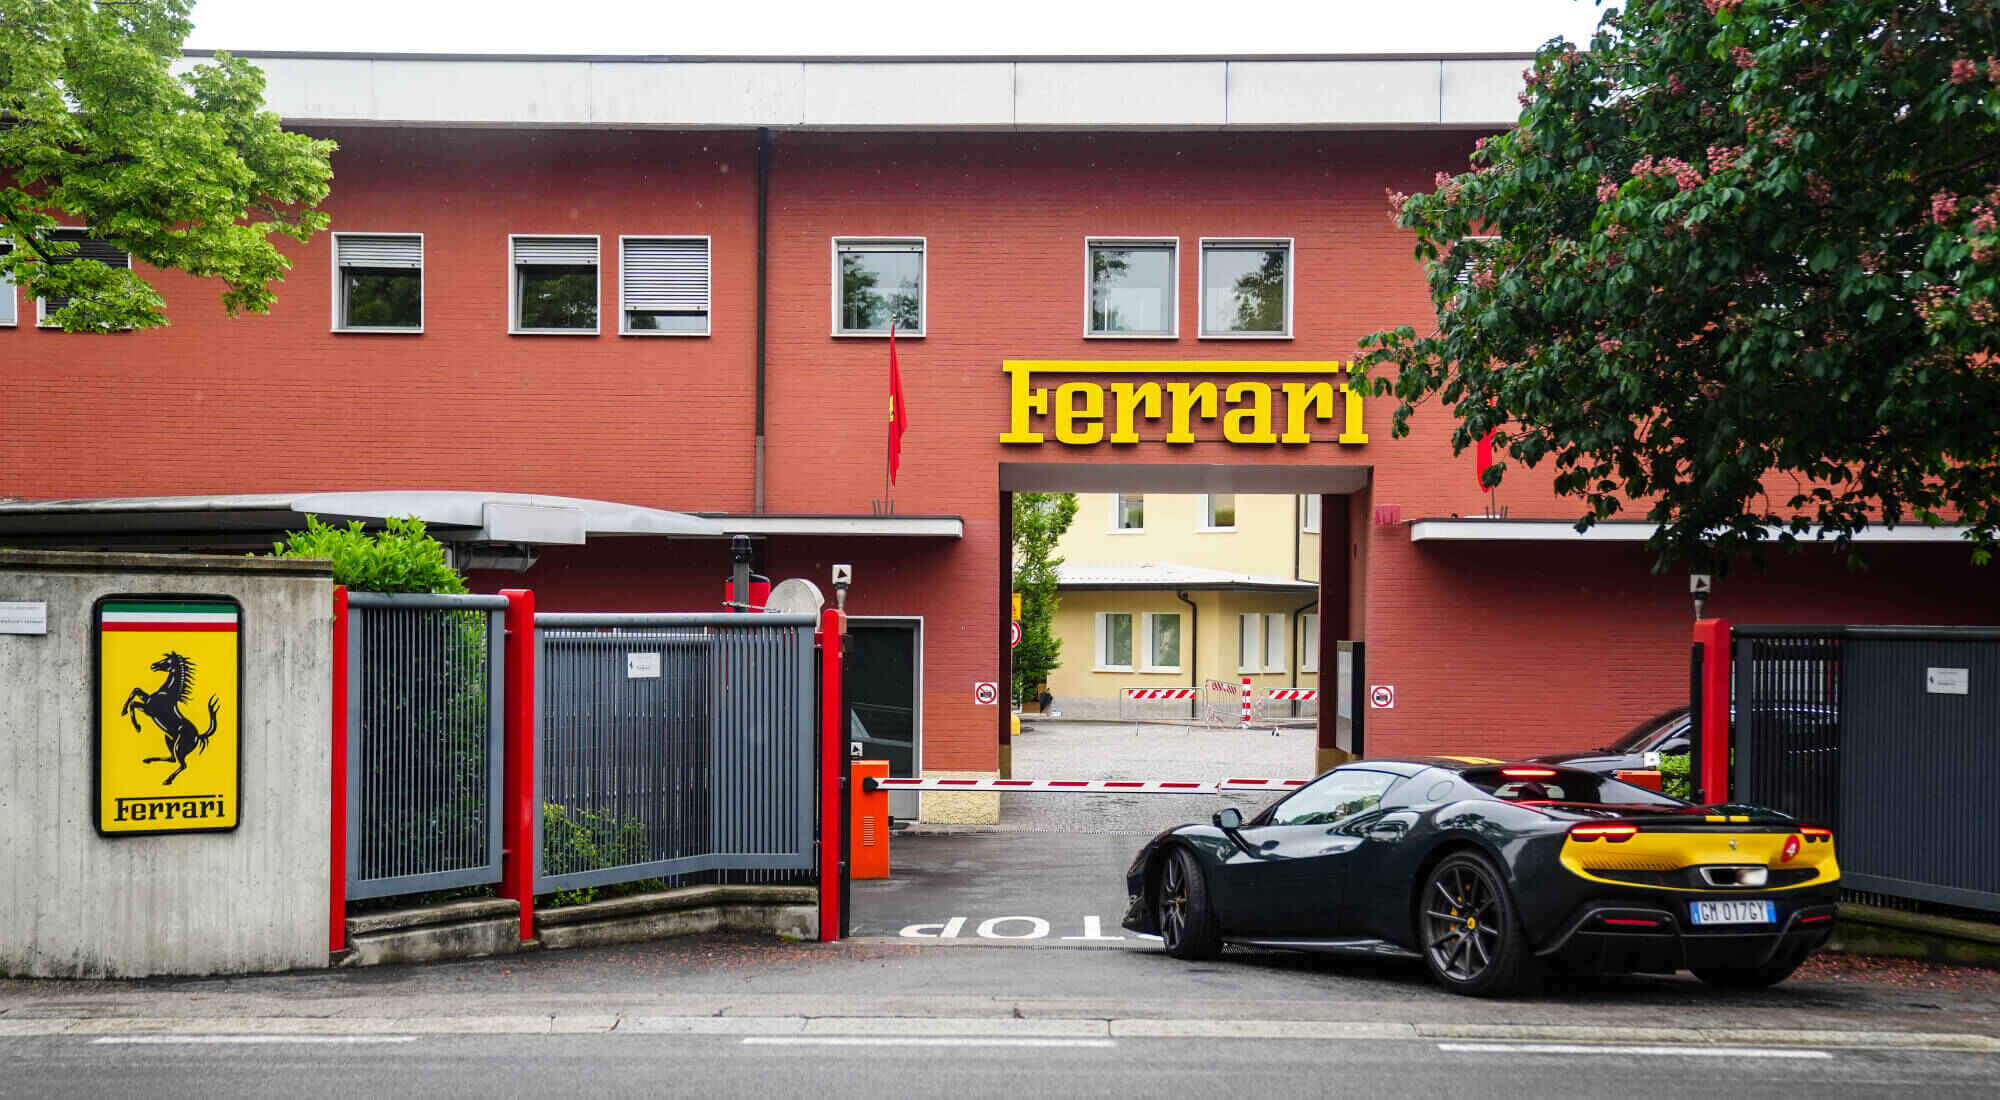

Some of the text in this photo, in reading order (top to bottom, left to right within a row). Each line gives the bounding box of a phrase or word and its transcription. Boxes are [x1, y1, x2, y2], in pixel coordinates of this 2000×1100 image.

[1000, 360, 1368, 444] Ferrari
[114, 794, 225, 821] Ferrari
[1701, 903, 1719, 921] GM
[1723, 902, 1764, 921] 017GY
[898, 916, 1166, 940] TOP
